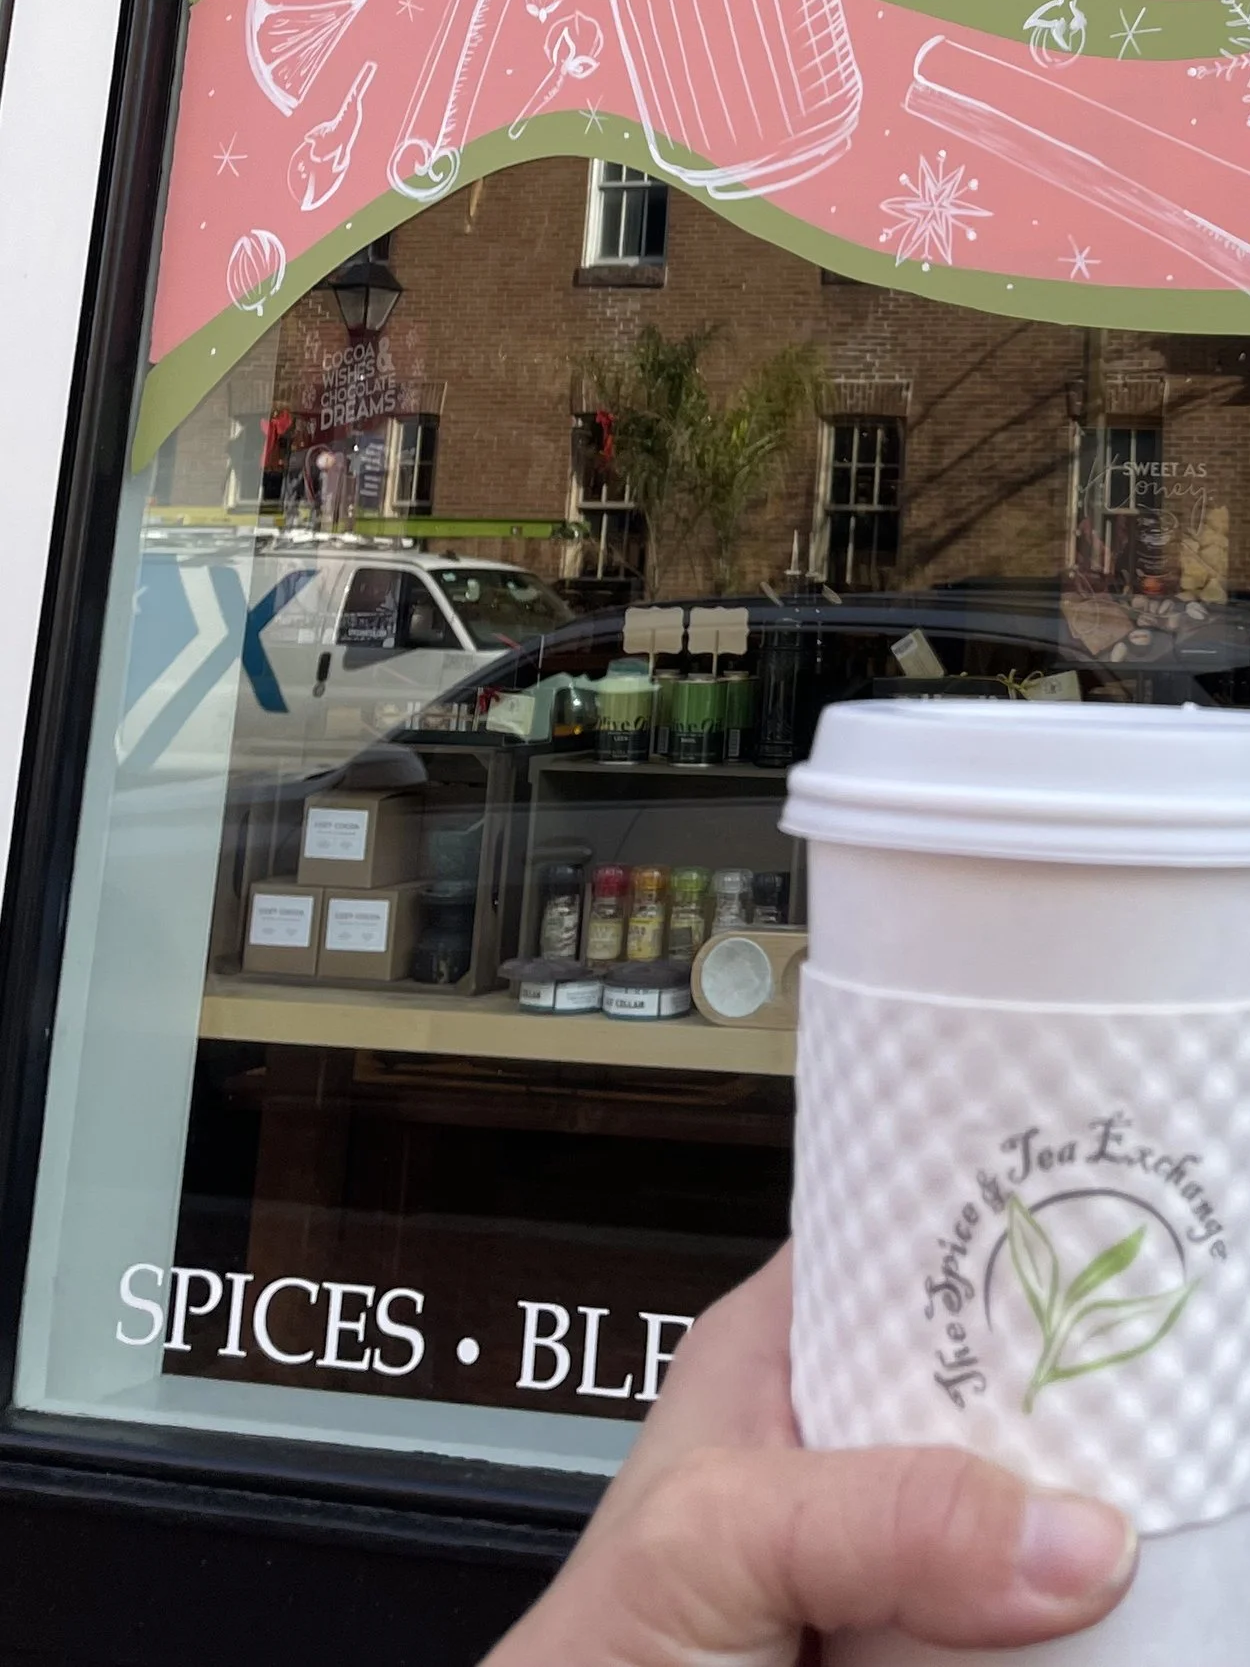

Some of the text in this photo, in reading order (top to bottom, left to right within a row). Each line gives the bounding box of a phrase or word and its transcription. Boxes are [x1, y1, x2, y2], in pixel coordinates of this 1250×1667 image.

[322, 336, 395, 372] COCOA &
[320, 372, 396, 408] CHOCOLATE
[322, 359, 375, 389] WISHES
[320, 389, 396, 431] DREAMS
[1122, 462, 1207, 477] SWEET AS
[924, 1110, 1228, 1409] The Spice & Tea Exchange
[116, 1262, 425, 1377] SPICES
